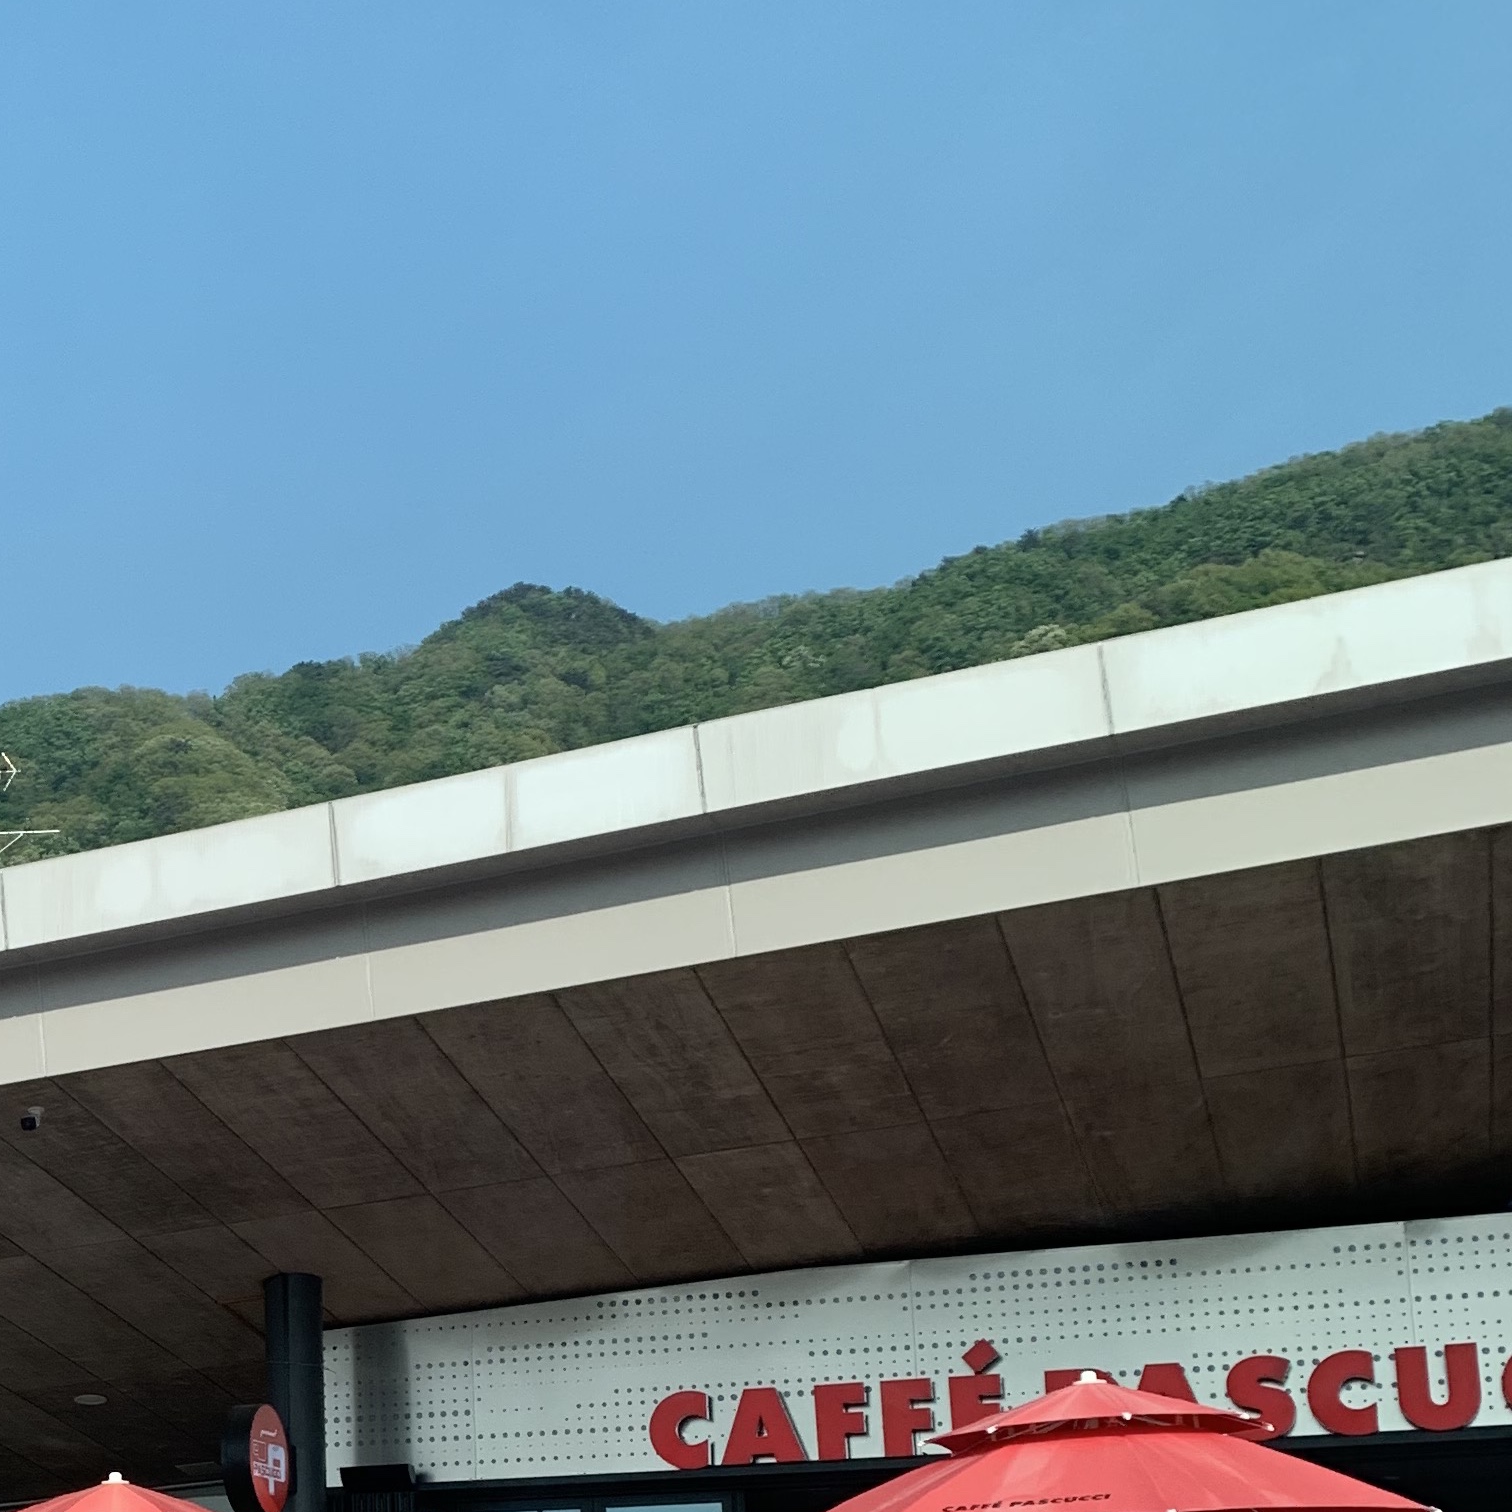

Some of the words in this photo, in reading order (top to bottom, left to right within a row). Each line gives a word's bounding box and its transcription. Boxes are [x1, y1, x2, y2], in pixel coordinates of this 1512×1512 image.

[649, 1338, 1002, 1471] CAFFÉ
[942, 1501, 1002, 1512] CAFFÉ
[1009, 1493, 1111, 1508] PASCUCCI
